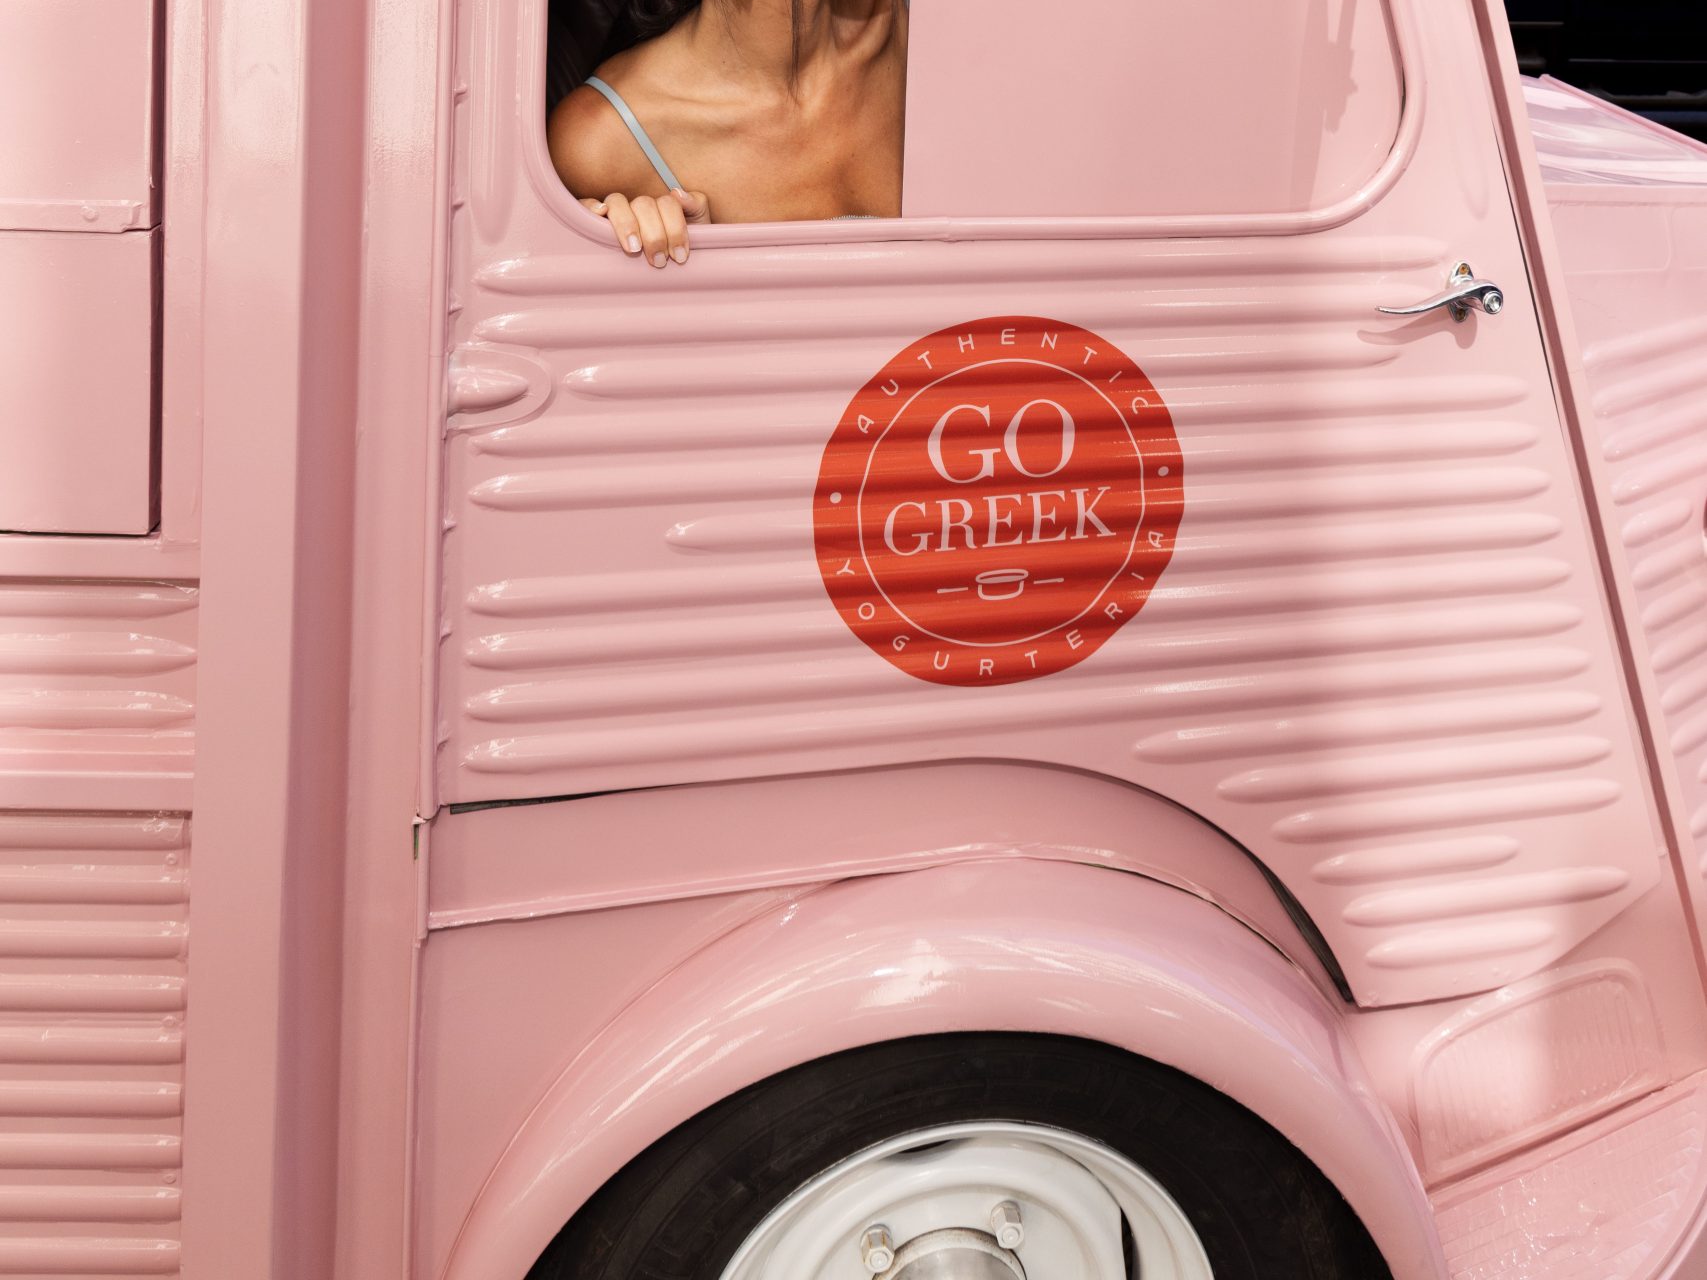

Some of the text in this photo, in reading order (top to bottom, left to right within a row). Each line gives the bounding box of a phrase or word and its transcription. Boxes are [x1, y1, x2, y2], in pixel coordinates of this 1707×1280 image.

[857, 328, 1149, 433] AUTHENTIC
[928, 399, 1075, 483] GO
[884, 486, 1116, 556] GREEK
[836, 530, 1164, 675] YOGURTERIA
